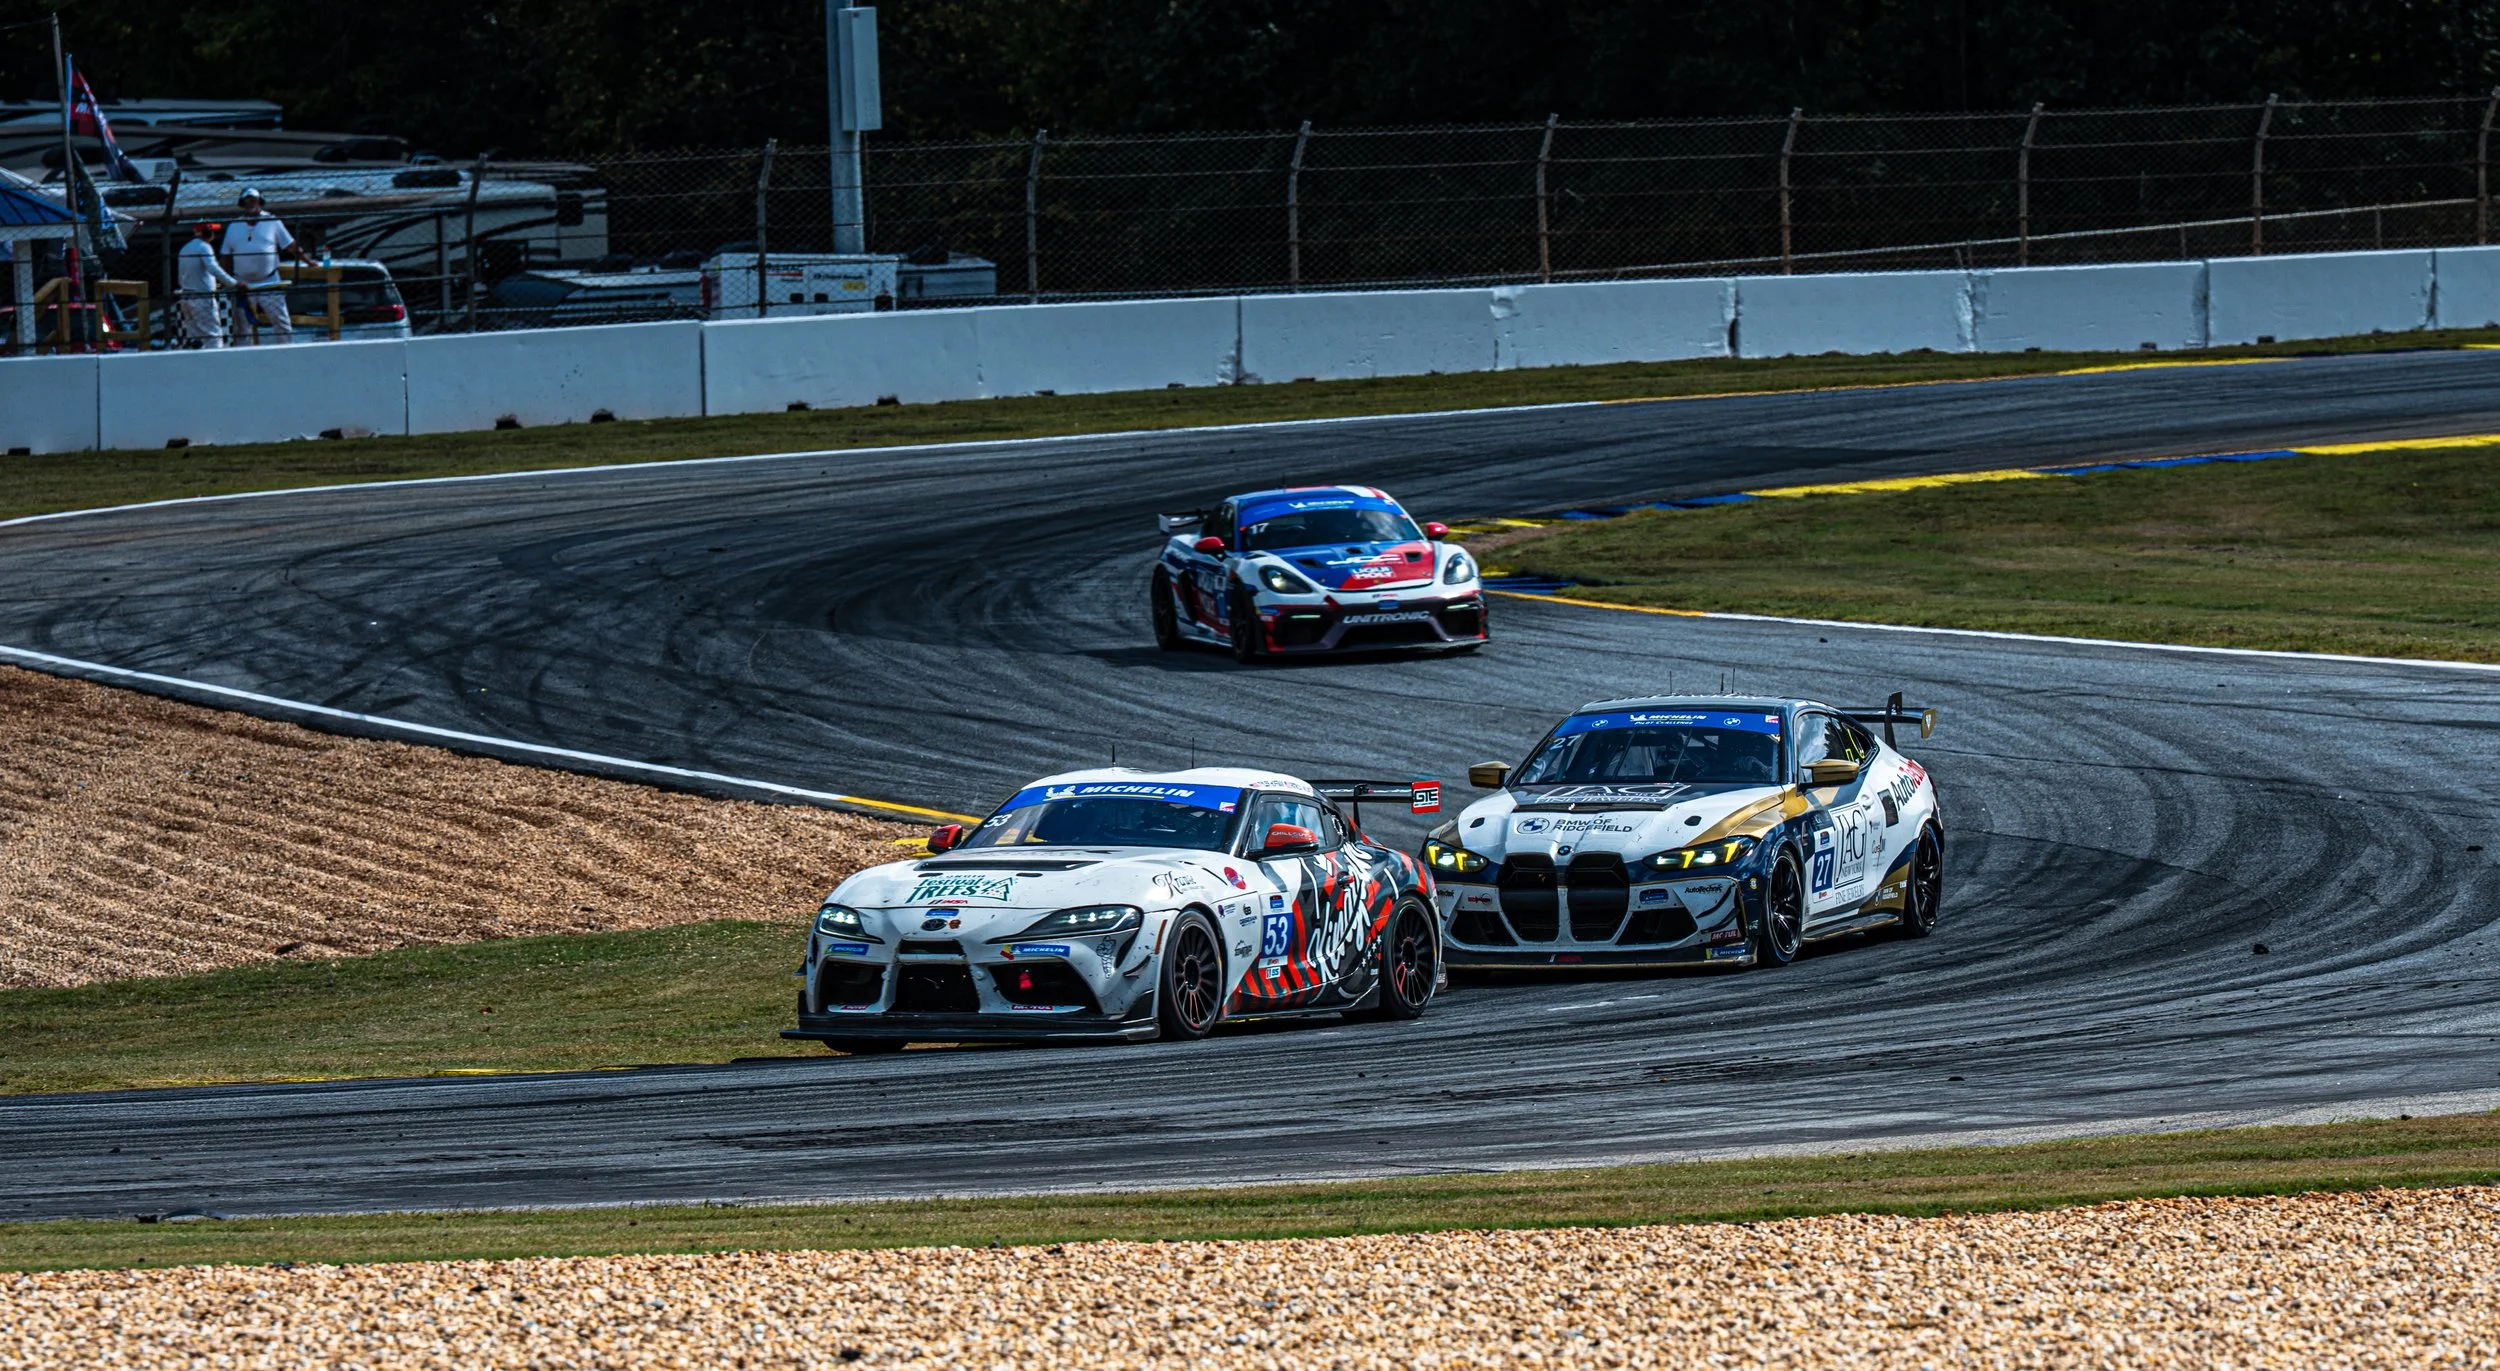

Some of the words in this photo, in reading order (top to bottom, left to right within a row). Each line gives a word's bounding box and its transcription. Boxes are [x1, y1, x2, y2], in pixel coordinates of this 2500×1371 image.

[1250, 523, 1269, 534] 17
[1343, 611, 1430, 624] UNITRONIC
[1550, 735, 1581, 750] 27
[1080, 785, 1196, 798] MICHELIN
[1414, 789, 1438, 803] GTE
[984, 813, 1013, 828] 53
[1552, 823, 1633, 833] RIDGEFIELD
[1834, 809, 1866, 883] JAG
[1815, 853, 1832, 888] 27
[905, 885, 980, 904] TREES
[1264, 916, 1289, 955] 53
